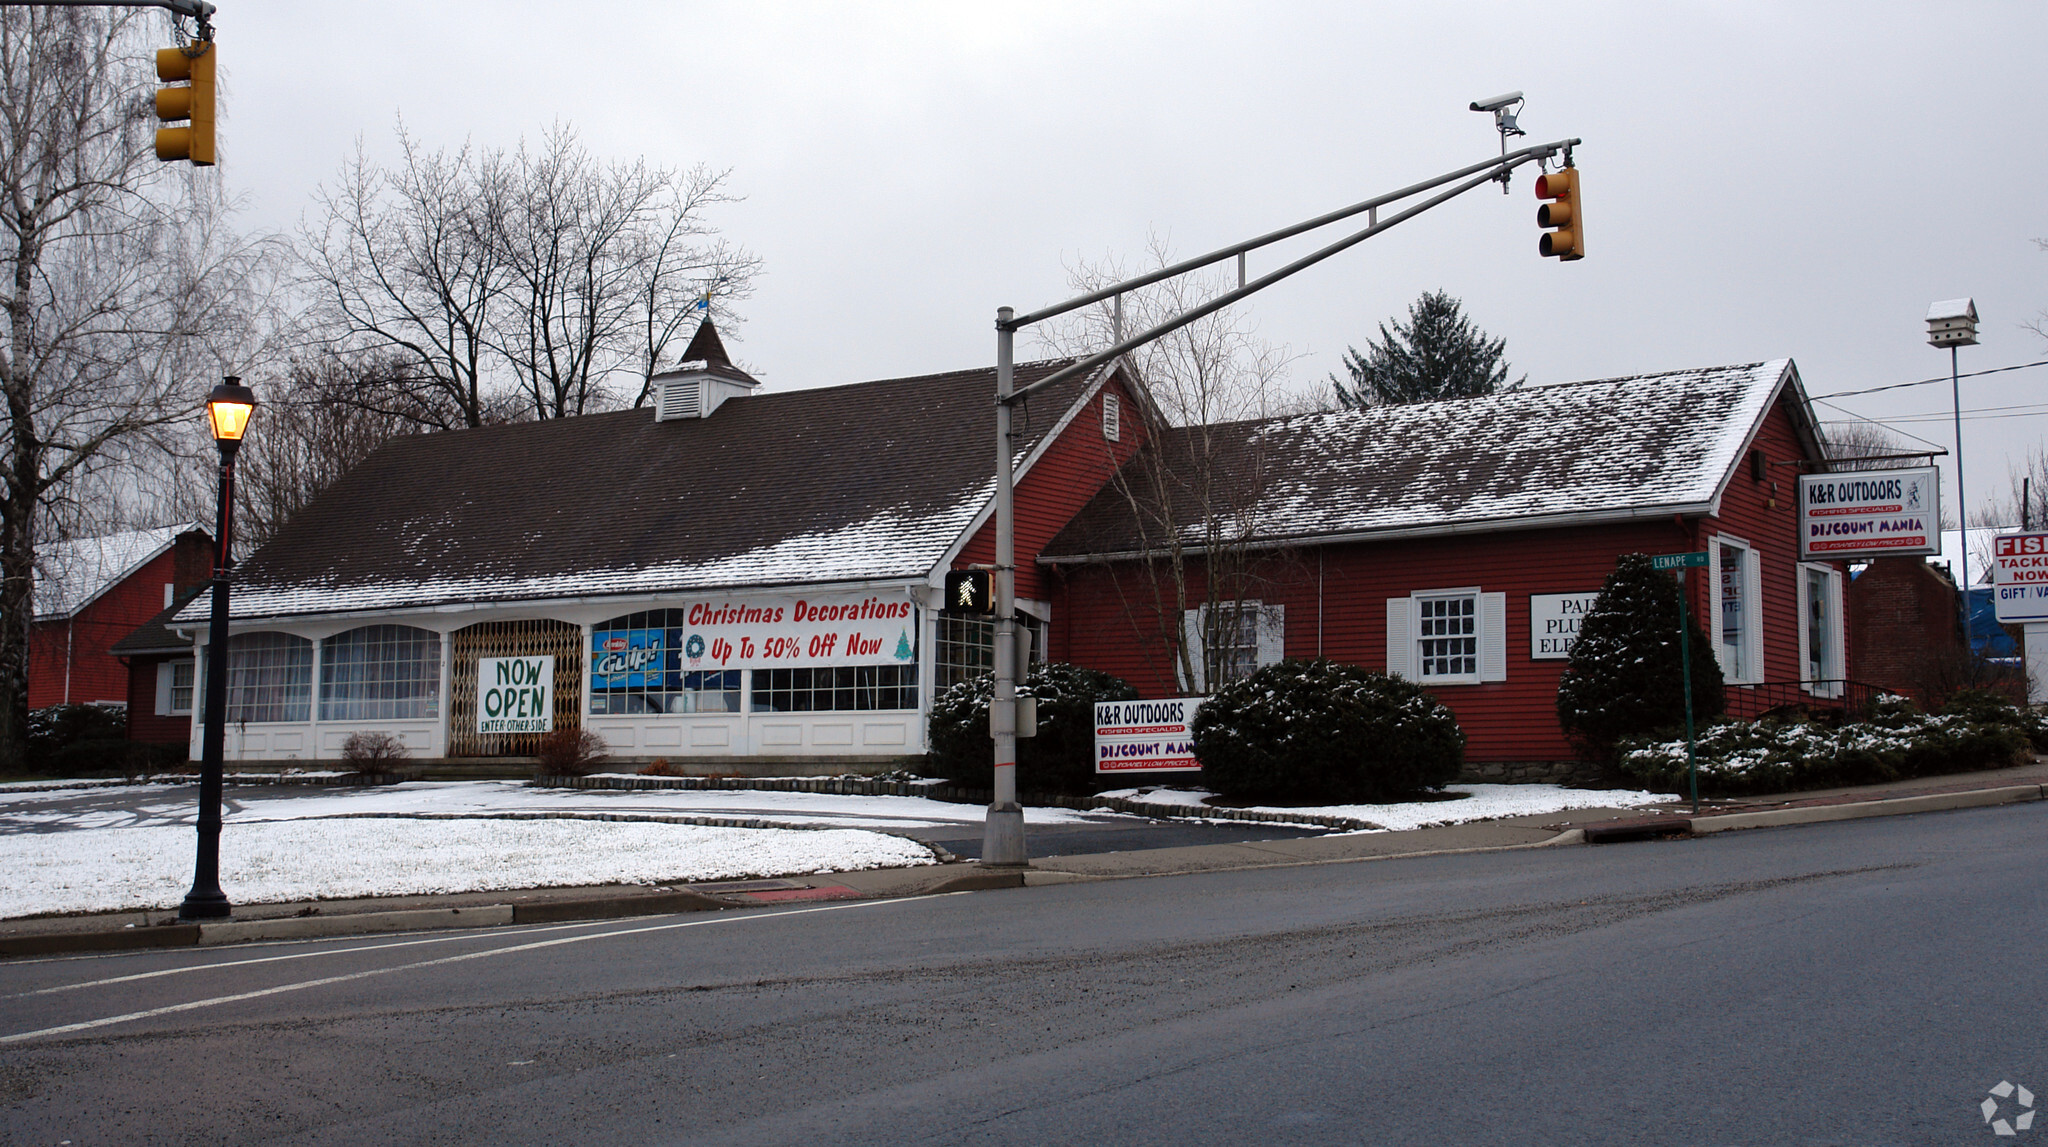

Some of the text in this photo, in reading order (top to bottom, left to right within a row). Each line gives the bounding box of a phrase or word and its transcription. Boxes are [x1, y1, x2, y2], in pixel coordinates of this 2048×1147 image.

[1810, 479, 1902, 504] K&R OUTDOORS
[1811, 518, 1923, 536] DISCOUNT MANIA
[1654, 555, 1687, 568] LENAPE
[2014, 570, 2048, 581] NOW
[2001, 587, 2026, 600] GIFT
[688, 597, 910, 626] Christmas Decorations
[598, 639, 660, 676] Gulp!
[712, 637, 732, 666] Up
[740, 637, 754, 659] To
[763, 637, 800, 659] 50%
[808, 633, 837, 657] Off
[846, 632, 883, 656] Now
[497, 659, 543, 686] NOW
[485, 686, 545, 718] OPEN
[1097, 702, 1184, 725] K&R OUTDOORS
[482, 718, 548, 732] ENTER OTHER SIDE
[1101, 743, 1160, 758] DISCOUNT
